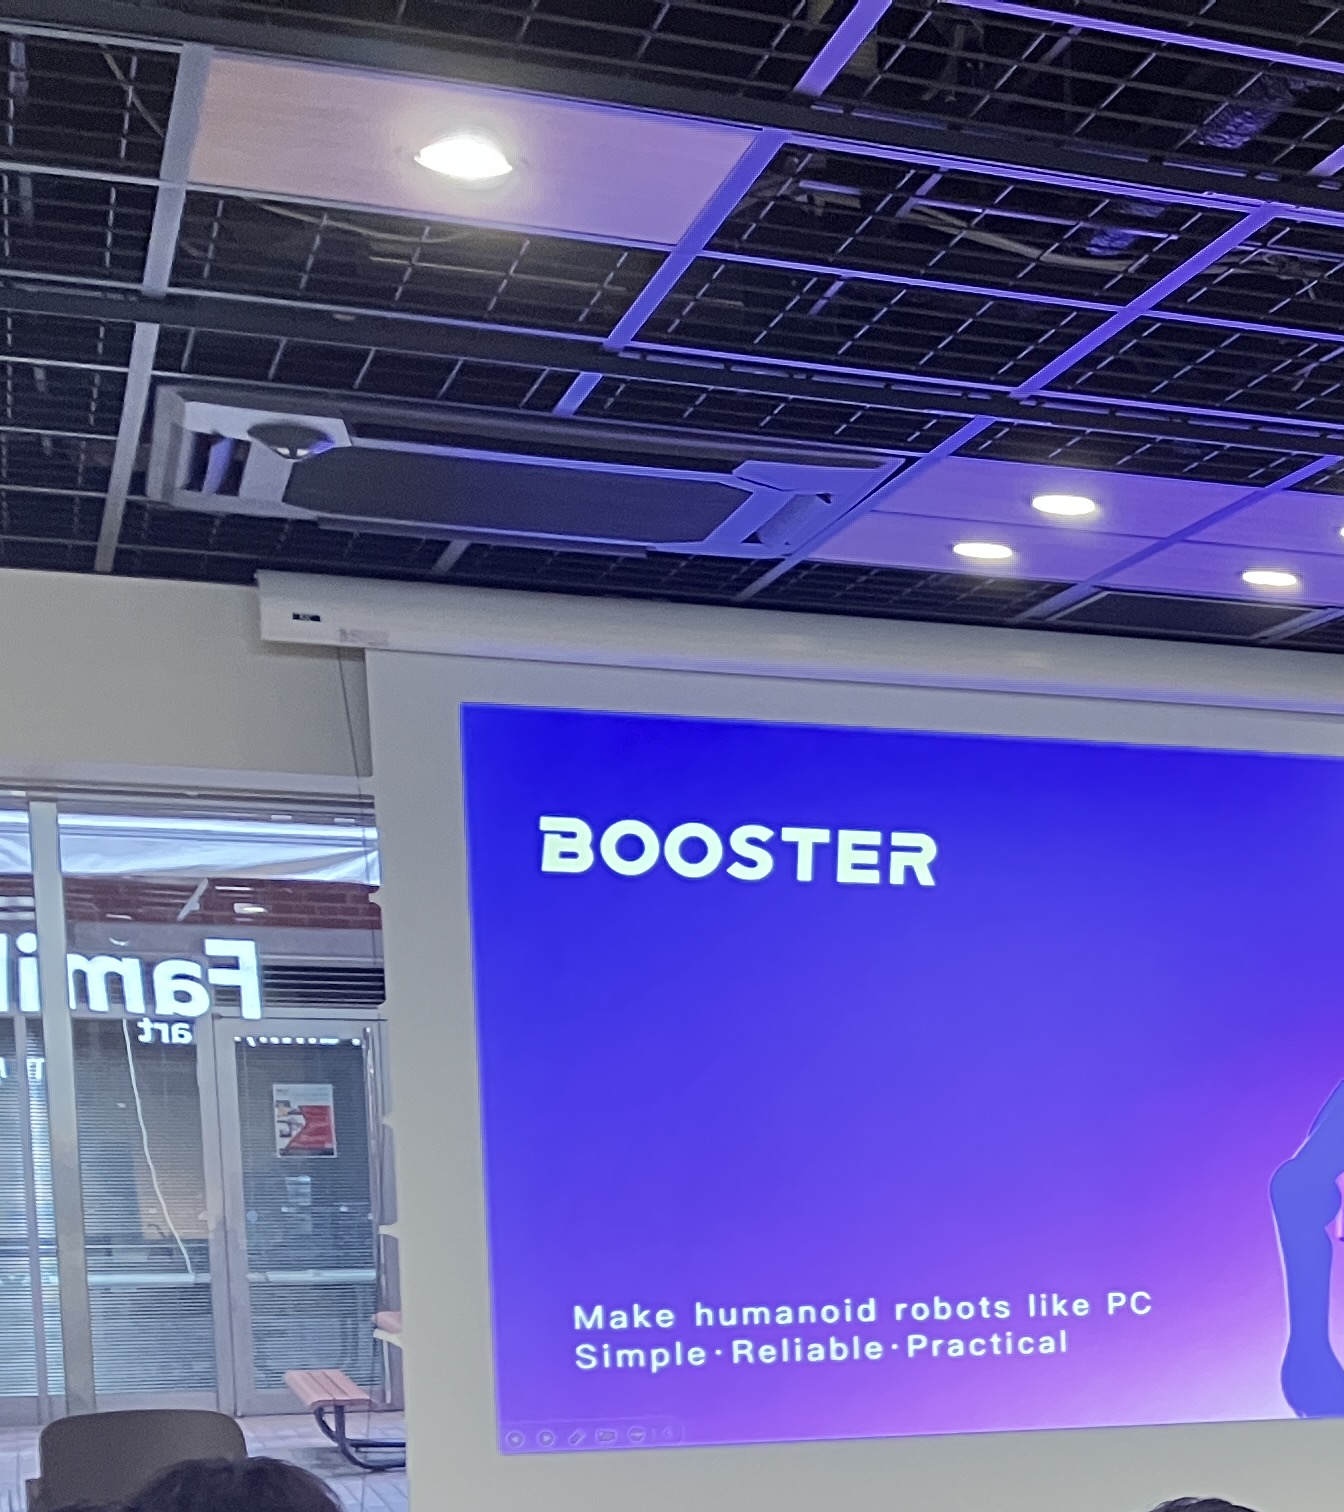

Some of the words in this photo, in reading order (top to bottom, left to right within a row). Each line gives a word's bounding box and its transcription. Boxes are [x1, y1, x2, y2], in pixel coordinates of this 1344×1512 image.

[538, 815, 938, 887] BOOSTER
[573, 1303, 675, 1330] Make
[695, 1297, 876, 1327] humanoid
[895, 1296, 1011, 1321] robots
[1028, 1293, 1090, 1318] like
[1107, 1290, 1152, 1316] PC
